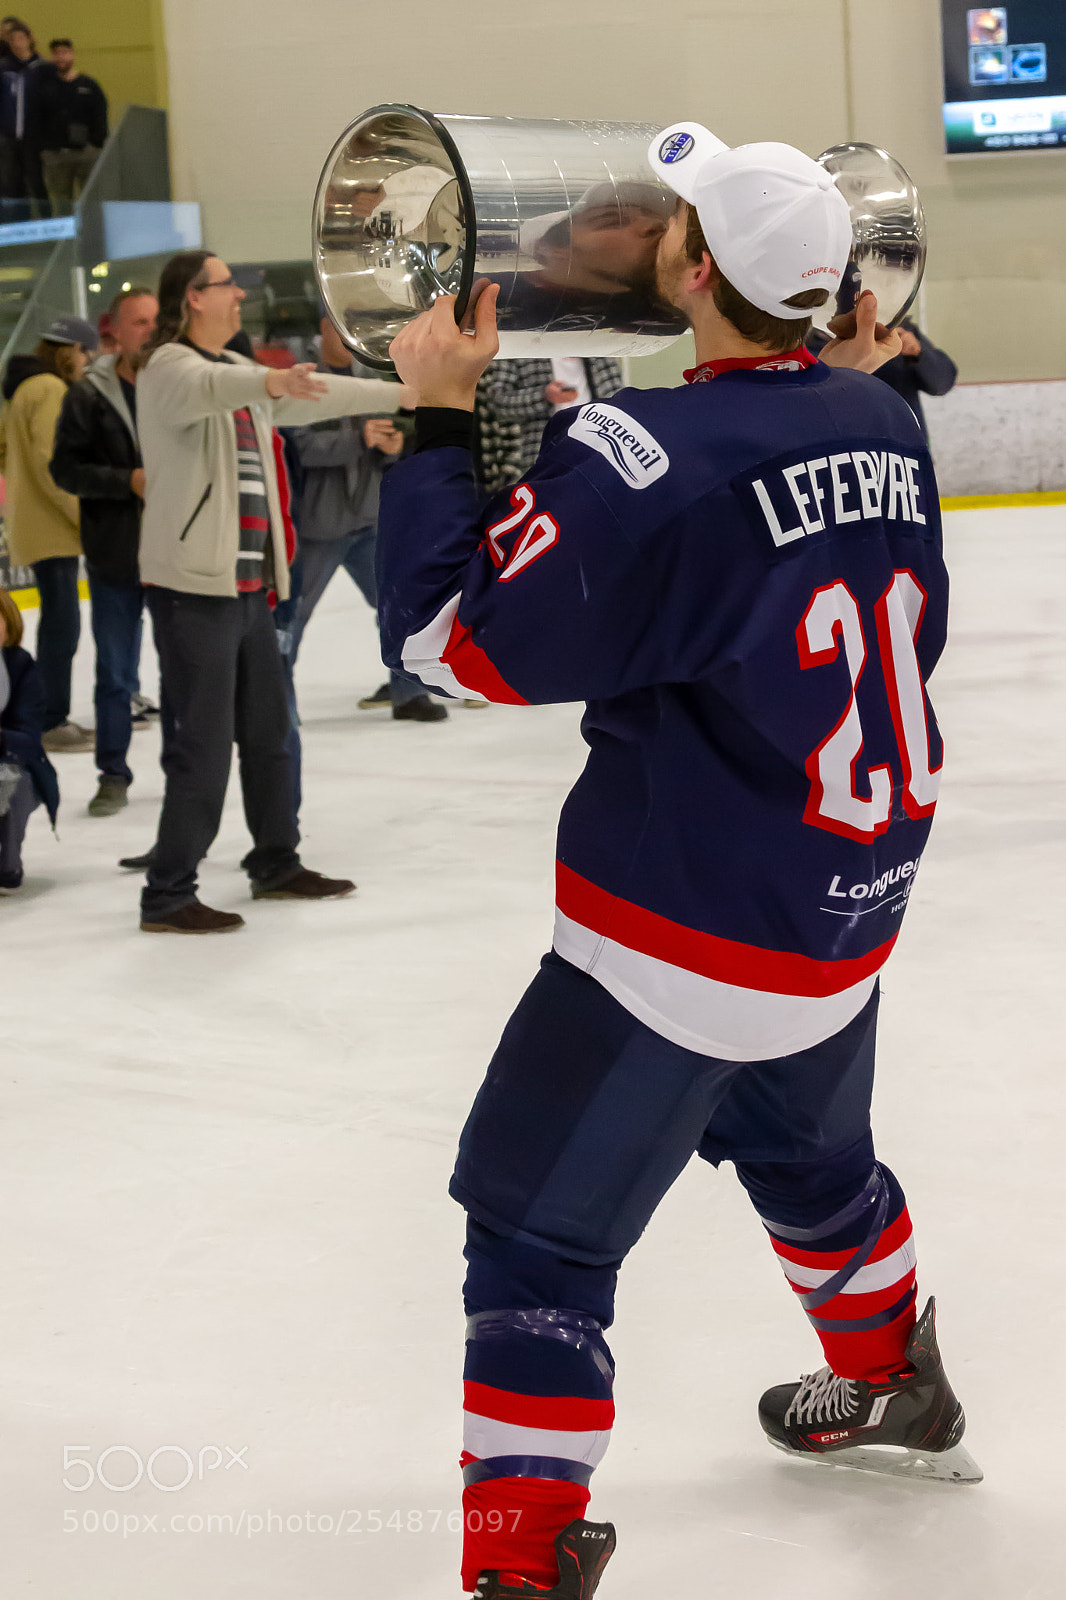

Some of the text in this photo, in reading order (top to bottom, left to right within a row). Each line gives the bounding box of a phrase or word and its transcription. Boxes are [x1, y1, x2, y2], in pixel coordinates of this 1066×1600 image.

[801, 266, 829, 279] COUPE
[581, 404, 662, 472] longueuil
[484, 482, 561, 584] 20
[751, 450, 927, 548] LEFEBVRE
[795, 567, 944, 845] 20
[820, 1430, 849, 1442] CCM
[581, 1529, 608, 1540] CCM
